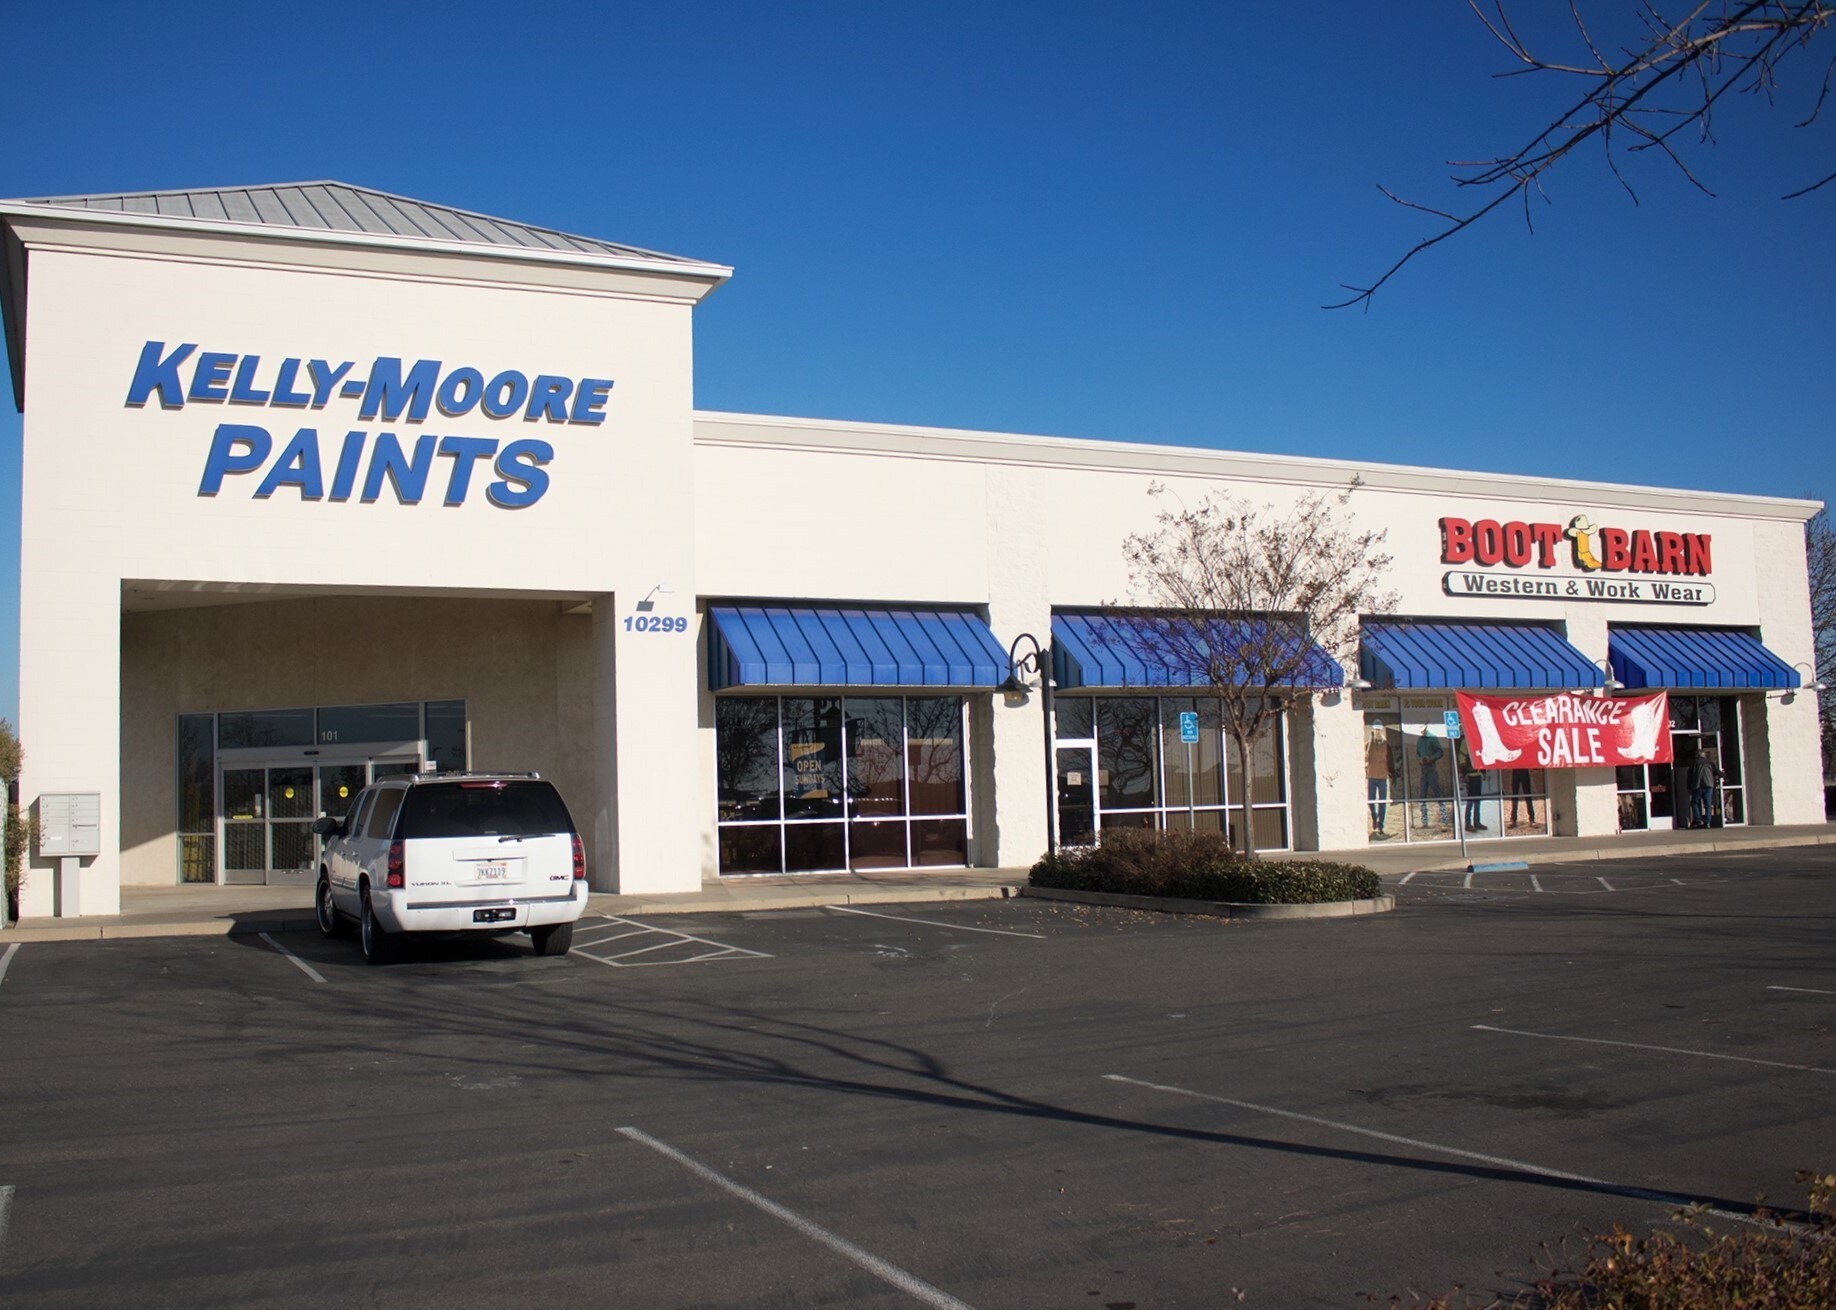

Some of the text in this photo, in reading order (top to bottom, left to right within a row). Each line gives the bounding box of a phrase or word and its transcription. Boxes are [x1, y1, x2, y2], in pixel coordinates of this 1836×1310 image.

[124, 340, 614, 424] KELLY-MOORE
[197, 423, 555, 510] PAINTS
[1438, 517, 1711, 577] BOOT BARN
[1462, 574, 1702, 600] Western & Work Wear
[623, 616, 688, 632] 10299
[1502, 695, 1628, 727] CLEARANCE
[321, 730, 338, 741] 101
[1537, 727, 1606, 766] SALE
[794, 773, 825, 785] SUNDAYS
[796, 759, 822, 773] OPEN
